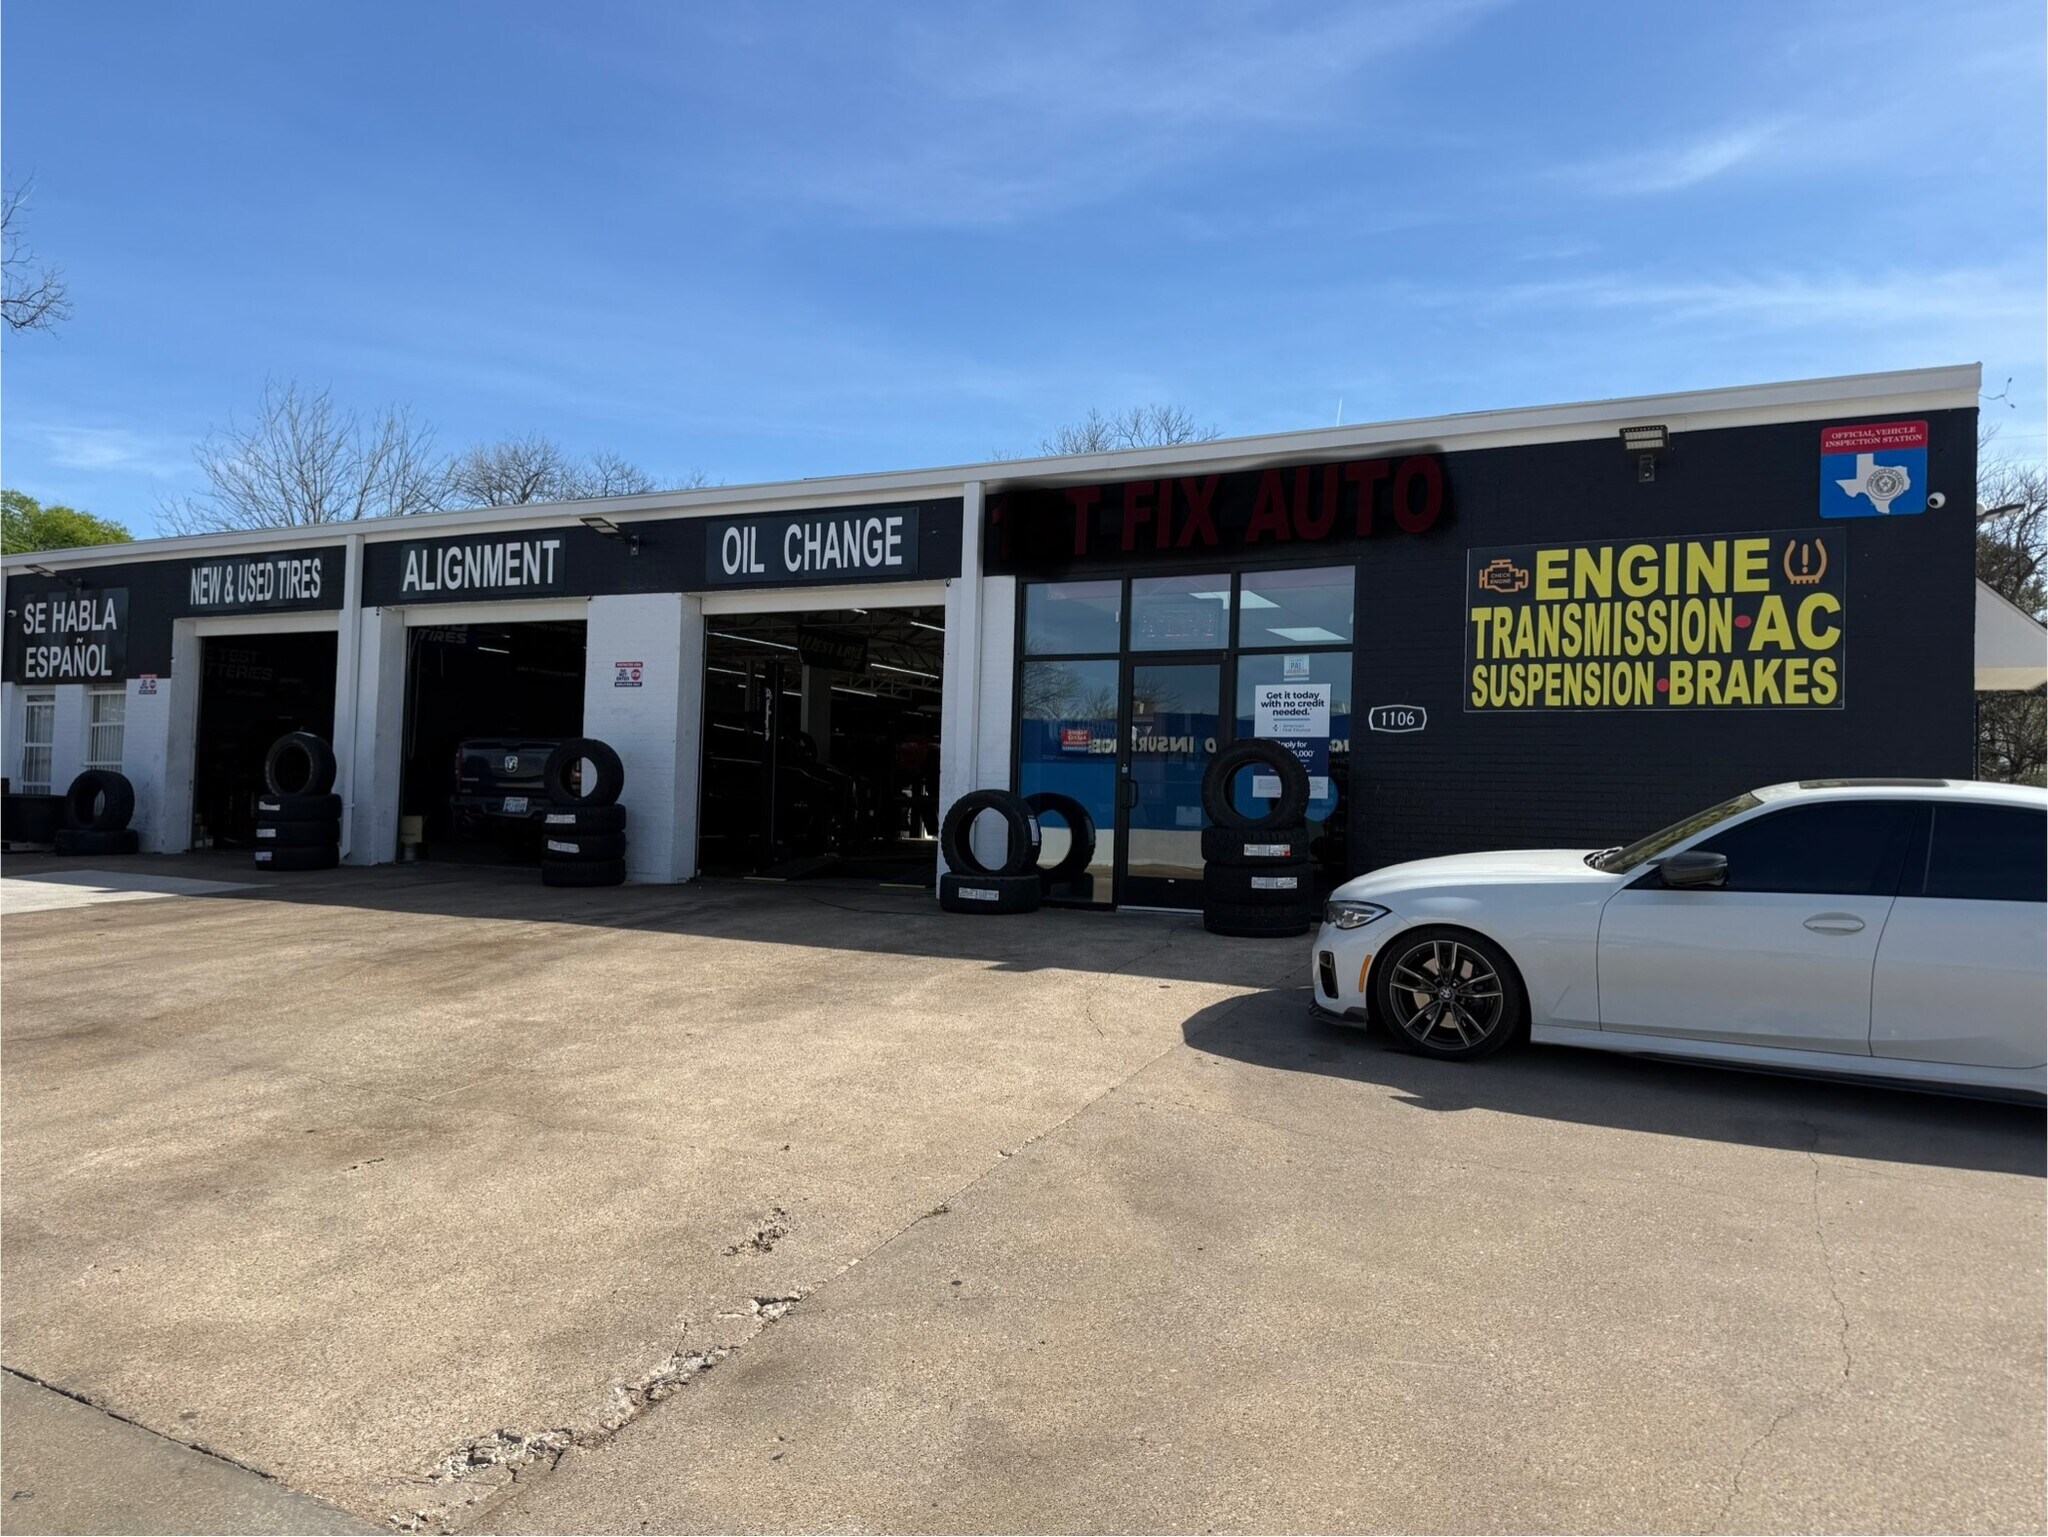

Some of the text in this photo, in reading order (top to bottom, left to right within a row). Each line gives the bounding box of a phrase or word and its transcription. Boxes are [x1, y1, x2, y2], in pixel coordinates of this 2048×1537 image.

[1825, 434, 1923, 448] INSPECTION STATION
[1831, 426, 1917, 440] OFFICIAL VEHICLE
[1122, 474, 1223, 553] FIX
[1244, 454, 1445, 545] AUTO
[722, 516, 903, 575] OIL CHANGE
[190, 557, 321, 605] NEW & USED TIRES
[402, 539, 561, 592] ALIGNMENT
[1535, 538, 1771, 601] ENGINE
[23, 598, 117, 635] SE HABLA
[1471, 592, 1841, 660] TRANSMISSION AC
[25, 638, 112, 678] ESPAÑOL
[203, 662, 273, 681] TTERIES
[1266, 691, 1320, 701] Get it today
[1472, 657, 1838, 707] SUSPENSION BRAKES
[1260, 699, 1325, 708] with no credit
[1381, 711, 1415, 726] 1106
[1297, 740, 1307, 748] for
